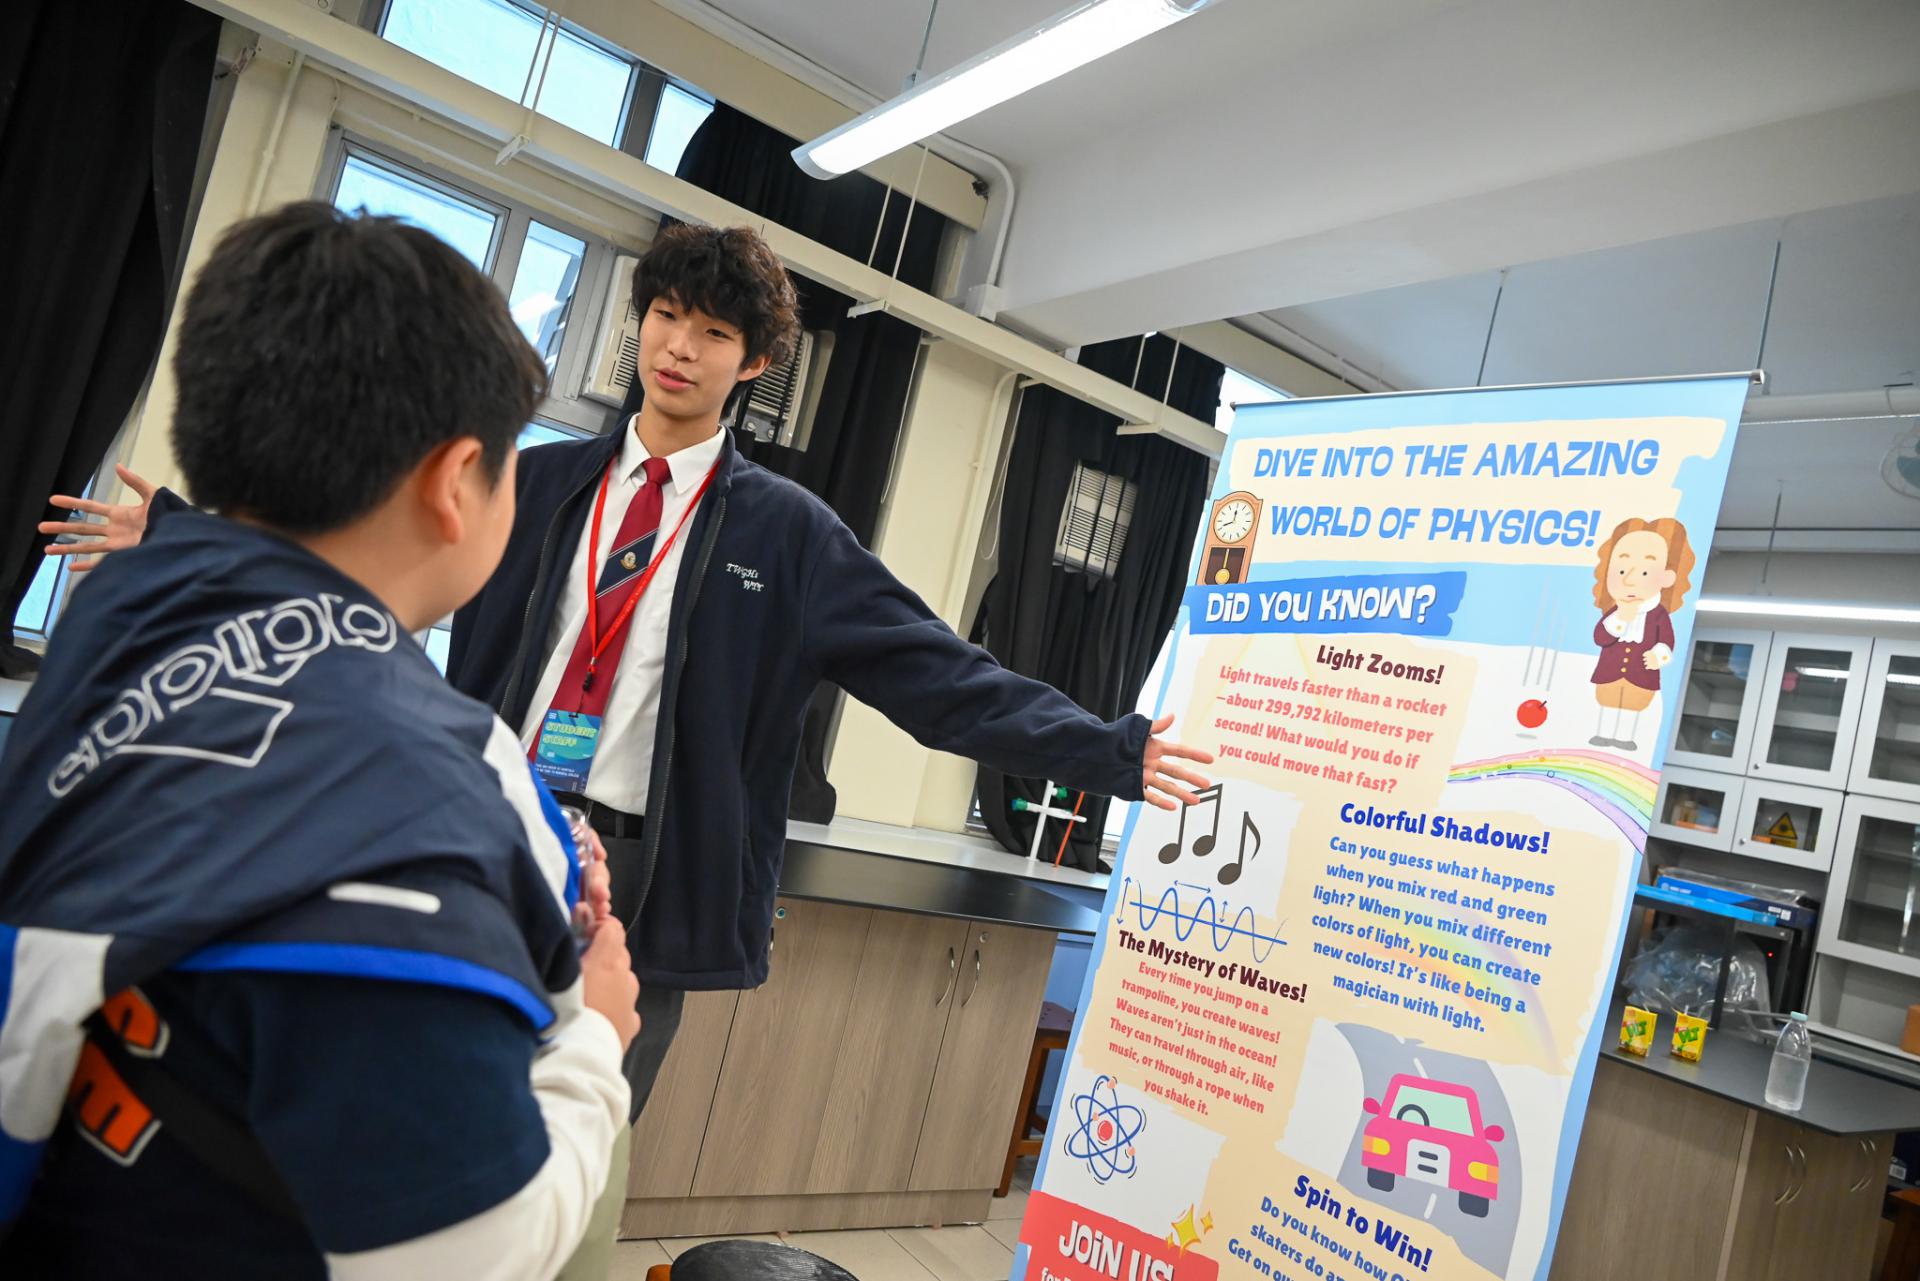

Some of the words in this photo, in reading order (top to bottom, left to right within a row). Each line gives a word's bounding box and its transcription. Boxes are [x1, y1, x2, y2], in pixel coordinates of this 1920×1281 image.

[1253, 448, 1318, 478] DIVE
[1321, 445, 1394, 478] INTO
[1405, 444, 1468, 478] THE
[1472, 439, 1660, 478] AMAZING
[1271, 505, 1372, 538] WORLD
[1378, 507, 1421, 540] OF
[1428, 507, 1601, 548] PHYSICS!
[1259, 591, 1313, 622] YOU
[1318, 584, 1436, 624] KNOW?
[1219, 665, 1252, 684] Light
[1253, 672, 1299, 692] travels
[1301, 678, 1344, 699] faster
[1345, 686, 1381, 706] than
[1382, 696, 1393, 708] a
[1395, 697, 1448, 717] rocket
[1316, 644, 1365, 671] Light
[1366, 653, 1445, 685] Zooms!
[1214, 718, 1265, 737] second!
[1265, 724, 1303, 745] What
[1304, 735, 1349, 755] would
[1350, 745, 1380, 762] you
[1382, 749, 1403, 767] do
[1404, 752, 1421, 770] if
[1264, 698, 1323, 722] 299,792
[1322, 708, 1404, 738] kilometers
[1405, 728, 1434, 744] per
[1218, 744, 1243, 759] you
[1244, 750, 1281, 768] could
[1282, 758, 1320, 777] move
[1322, 764, 1354, 785] that
[1355, 771, 1398, 794] fast?
[1340, 802, 1427, 835] Colorful
[1430, 815, 1551, 855] Shadows!
[1326, 864, 1364, 883] when
[1367, 874, 1394, 890] you
[1397, 880, 1427, 898] mix
[1430, 888, 1458, 905] red
[1460, 895, 1494, 913] and
[1497, 904, 1547, 926] green
[1329, 836, 1357, 855] Can
[1359, 845, 1386, 861] you
[1388, 852, 1433, 871] guess
[1437, 860, 1479, 880] what
[1481, 867, 1555, 897] happens
[1313, 885, 1356, 907] light?
[1358, 895, 1401, 920] When
[1404, 910, 1433, 929] you
[1437, 918, 1469, 937] mix
[1471, 924, 1552, 958] different
[1119, 929, 1146, 954] The
[1147, 938, 1216, 979] Mystery
[1217, 962, 1238, 981] of
[1239, 965, 1308, 1004] Waves!
[1311, 915, 1355, 935] colors
[1357, 925, 1375, 940] of
[1374, 927, 1414, 954] light,
[1419, 943, 1449, 961] you
[1452, 951, 1483, 970] can
[1485, 961, 1541, 986] create
[1313, 942, 1344, 960] new
[1345, 951, 1396, 975] colors!
[1430, 971, 1461, 994] like
[1464, 982, 1513, 1013] being
[1515, 1000, 1526, 1014] a
[1121, 978, 1179, 1010] trampoline,
[1180, 1000, 1201, 1017] you
[1202, 1009, 1237, 1029] create
[1238, 1021, 1281, 1045] waves!
[1138, 960, 1168, 983] Every
[1168, 972, 1192, 990] time
[1192, 982, 1214, 997] you
[1212, 986, 1243, 1009] jump
[1244, 999, 1260, 1013] on
[1260, 1005, 1269, 1016] a
[1333, 975, 1400, 1006] magician
[1403, 996, 1439, 1018] with
[1442, 1005, 1485, 1033] light.
[1110, 1016, 1134, 1039] They
[1134, 1029, 1152, 1044] can
[1153, 1035, 1185, 1057] travel
[1185, 1047, 1228, 1074] through
[1229, 1065, 1250, 1085] air,
[1251, 1072, 1275, 1093] like
[1116, 997, 1150, 1020] Waves
[1180, 1021, 1205, 1041] just
[1205, 1030, 1217, 1046] in
[1218, 1036, 1237, 1053] the
[1237, 1046, 1278, 1068] ocean!
[1108, 1041, 1140, 1064] music,
[1141, 1055, 1154, 1067] or
[1154, 1059, 1195, 1085] through
[1195, 1077, 1203, 1089] a
[1204, 1081, 1231, 1100] rope
[1232, 1092, 1265, 1114] when
[1143, 1079, 1164, 1096] you
[1163, 1087, 1196, 1110] shake
[1196, 1099, 1209, 1116] it.
[1260, 1196, 1280, 1218] Do
[1281, 1212, 1308, 1236] you
[1310, 1225, 1353, 1262] know
[1354, 1250, 1388, 1281] how
[1294, 1175, 1342, 1220] Spin
[1345, 1207, 1369, 1234] to
[1374, 1219, 1433, 1268] Win!
[1228, 1238, 1252, 1263] Get
[1253, 1257, 1271, 1276] on
[1250, 1224, 1303, 1264] skaters
[1304, 1256, 1324, 1277] do
